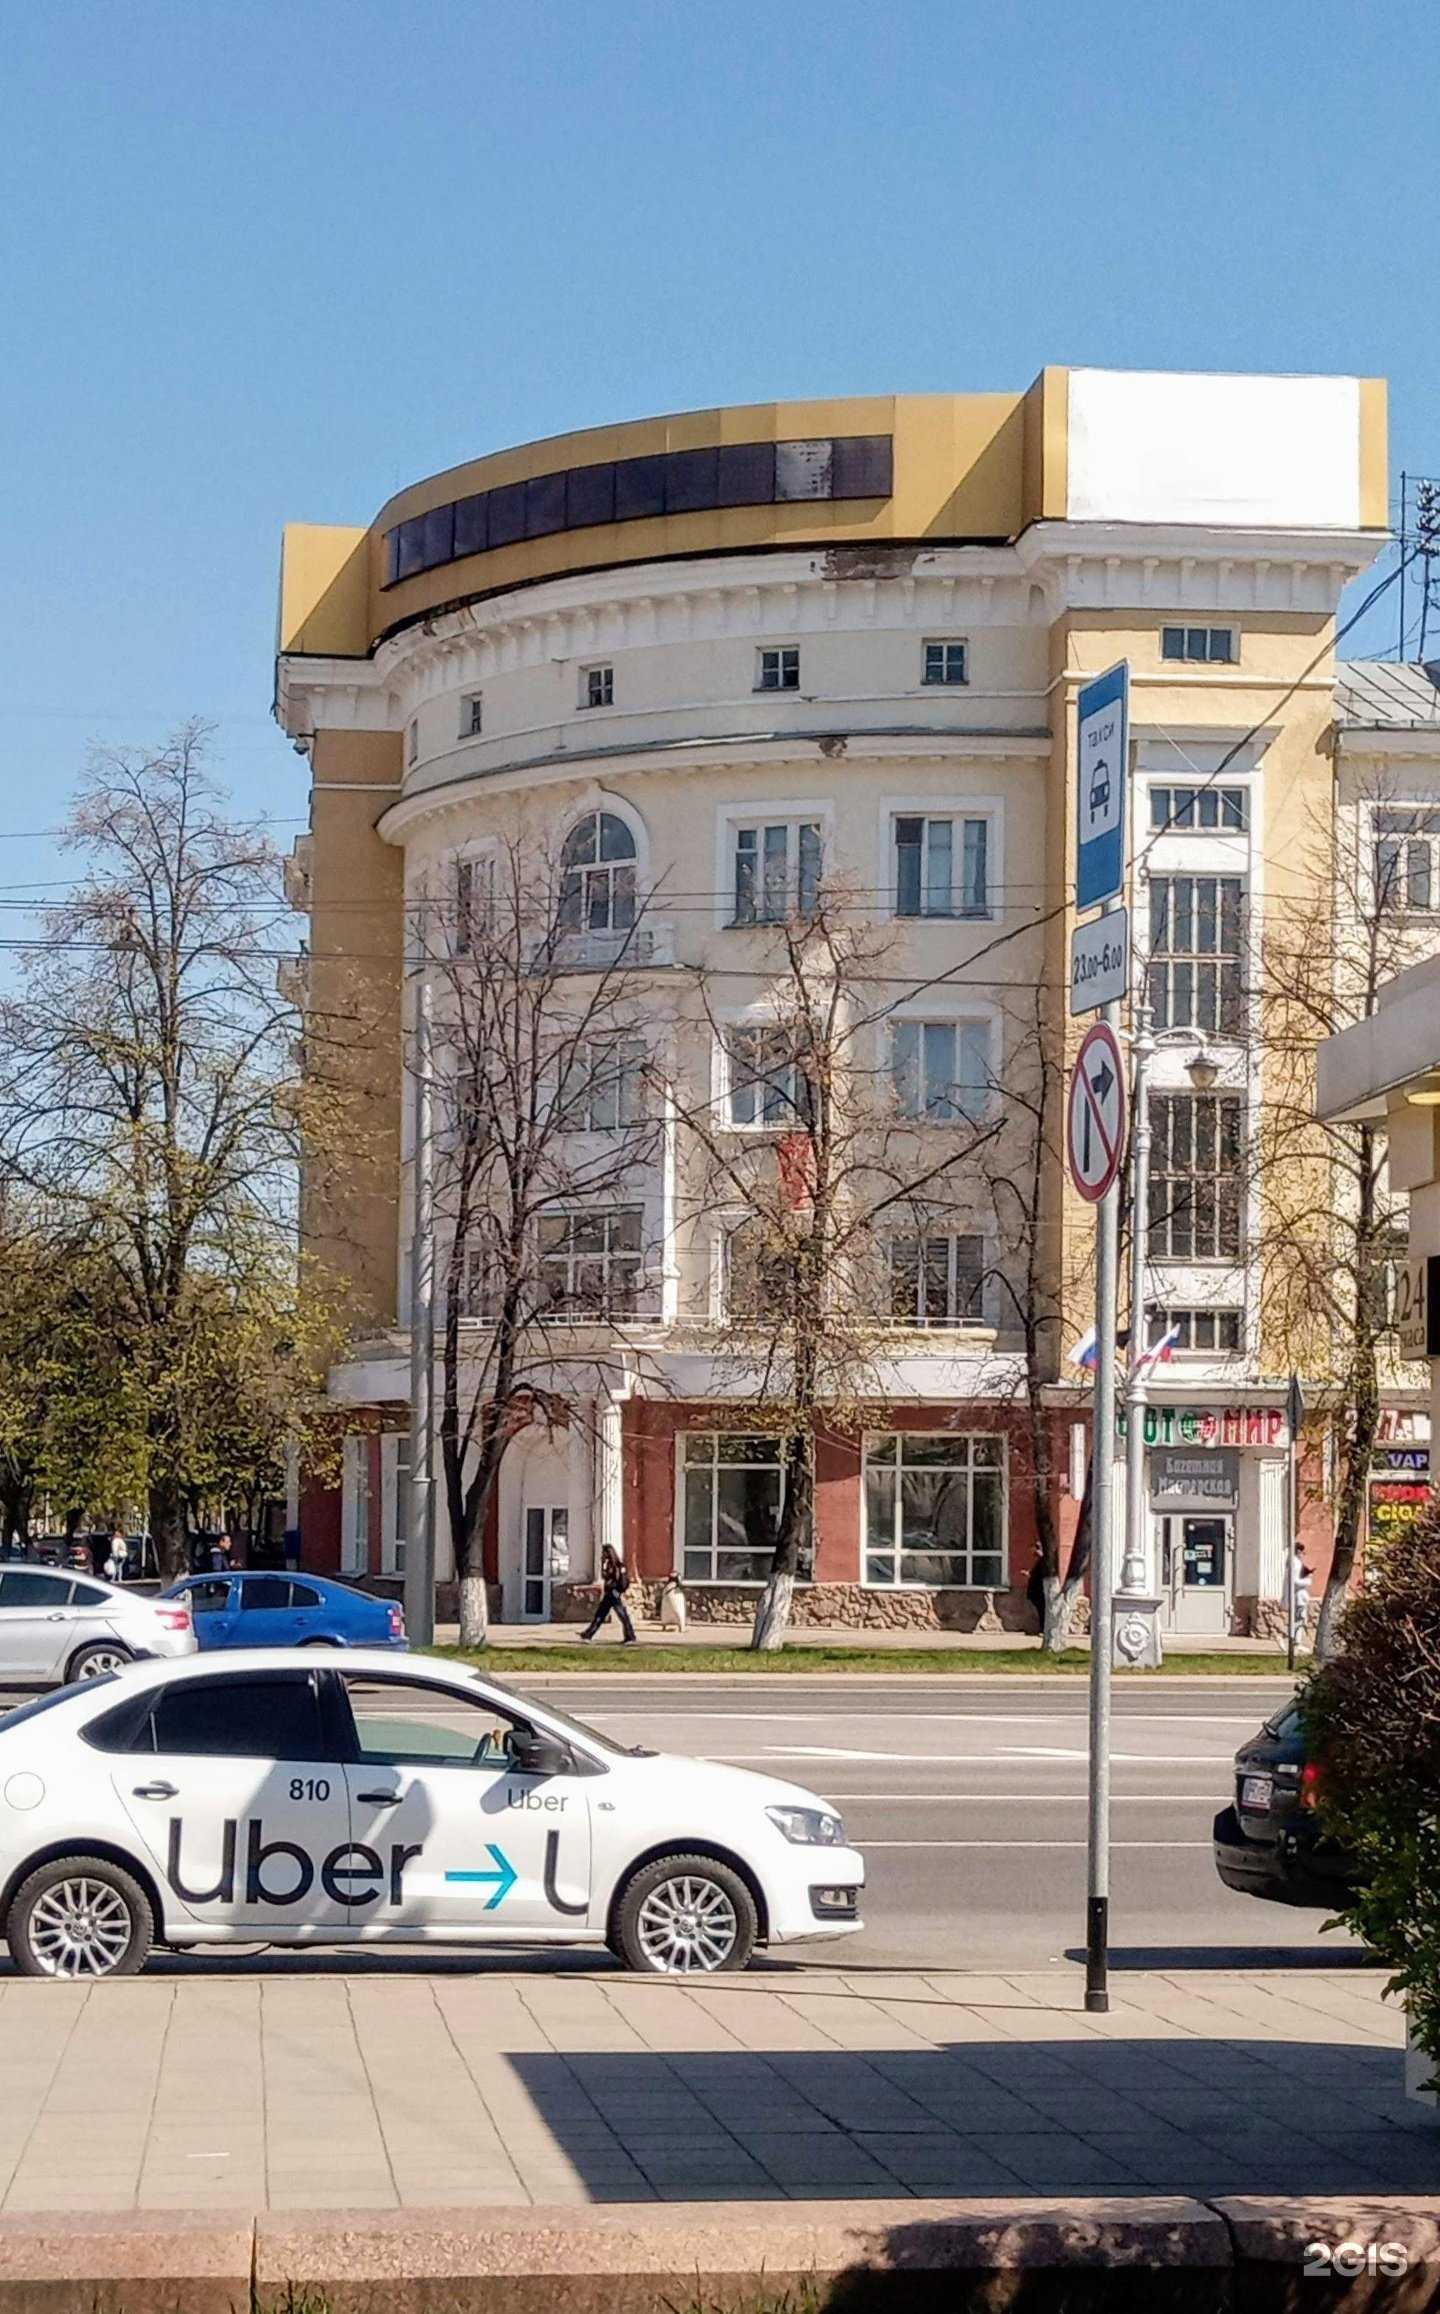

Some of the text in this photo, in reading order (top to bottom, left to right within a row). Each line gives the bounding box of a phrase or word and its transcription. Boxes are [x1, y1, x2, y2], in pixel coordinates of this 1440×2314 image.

[1401, 1266, 1425, 1321] 24
[289, 1779, 330, 1801] 810
[508, 1788, 569, 1812] Uber
[168, 1817, 423, 1906] Uber
